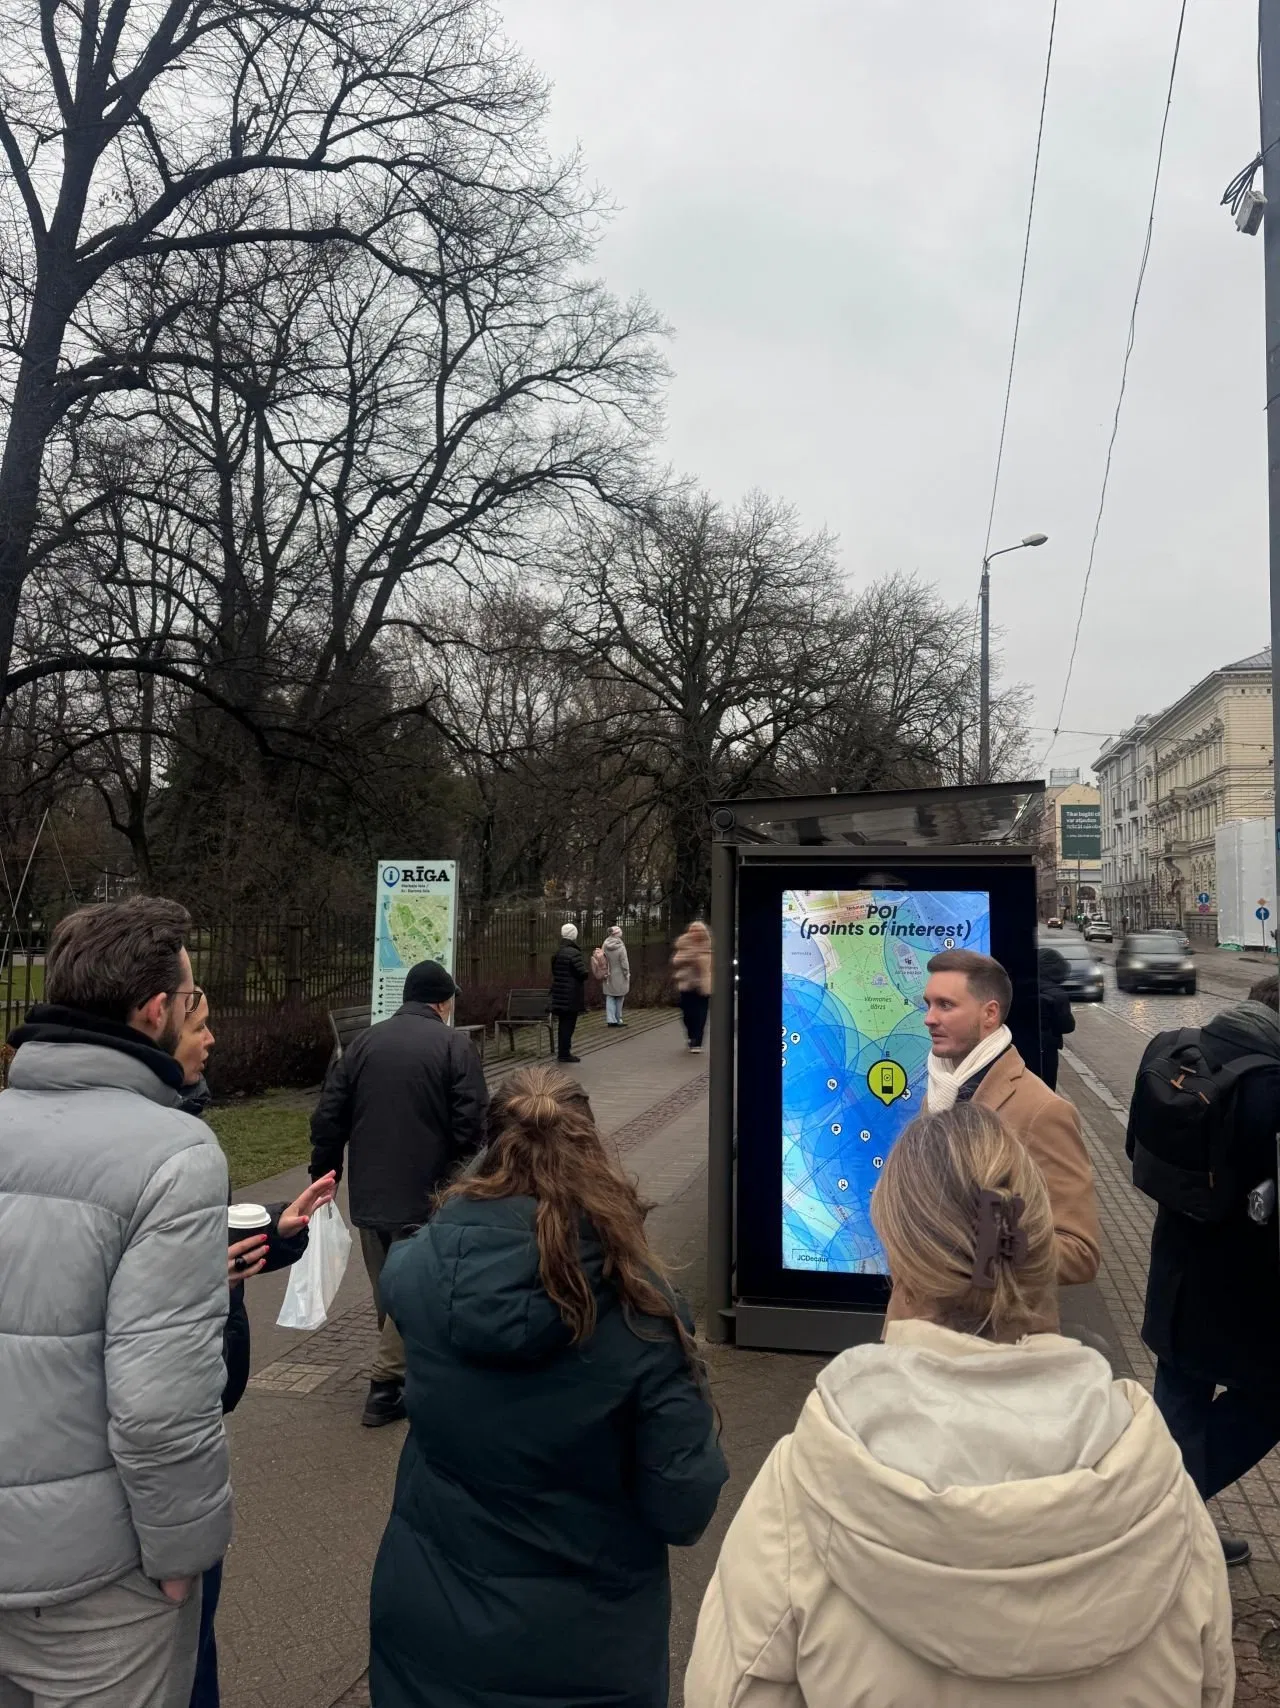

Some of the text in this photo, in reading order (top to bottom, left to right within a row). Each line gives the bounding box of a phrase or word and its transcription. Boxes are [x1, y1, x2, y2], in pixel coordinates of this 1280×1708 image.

[401, 866, 450, 882] RĪGA
[867, 905, 897, 919] POI
[800, 917, 972, 941] (points of interest)
